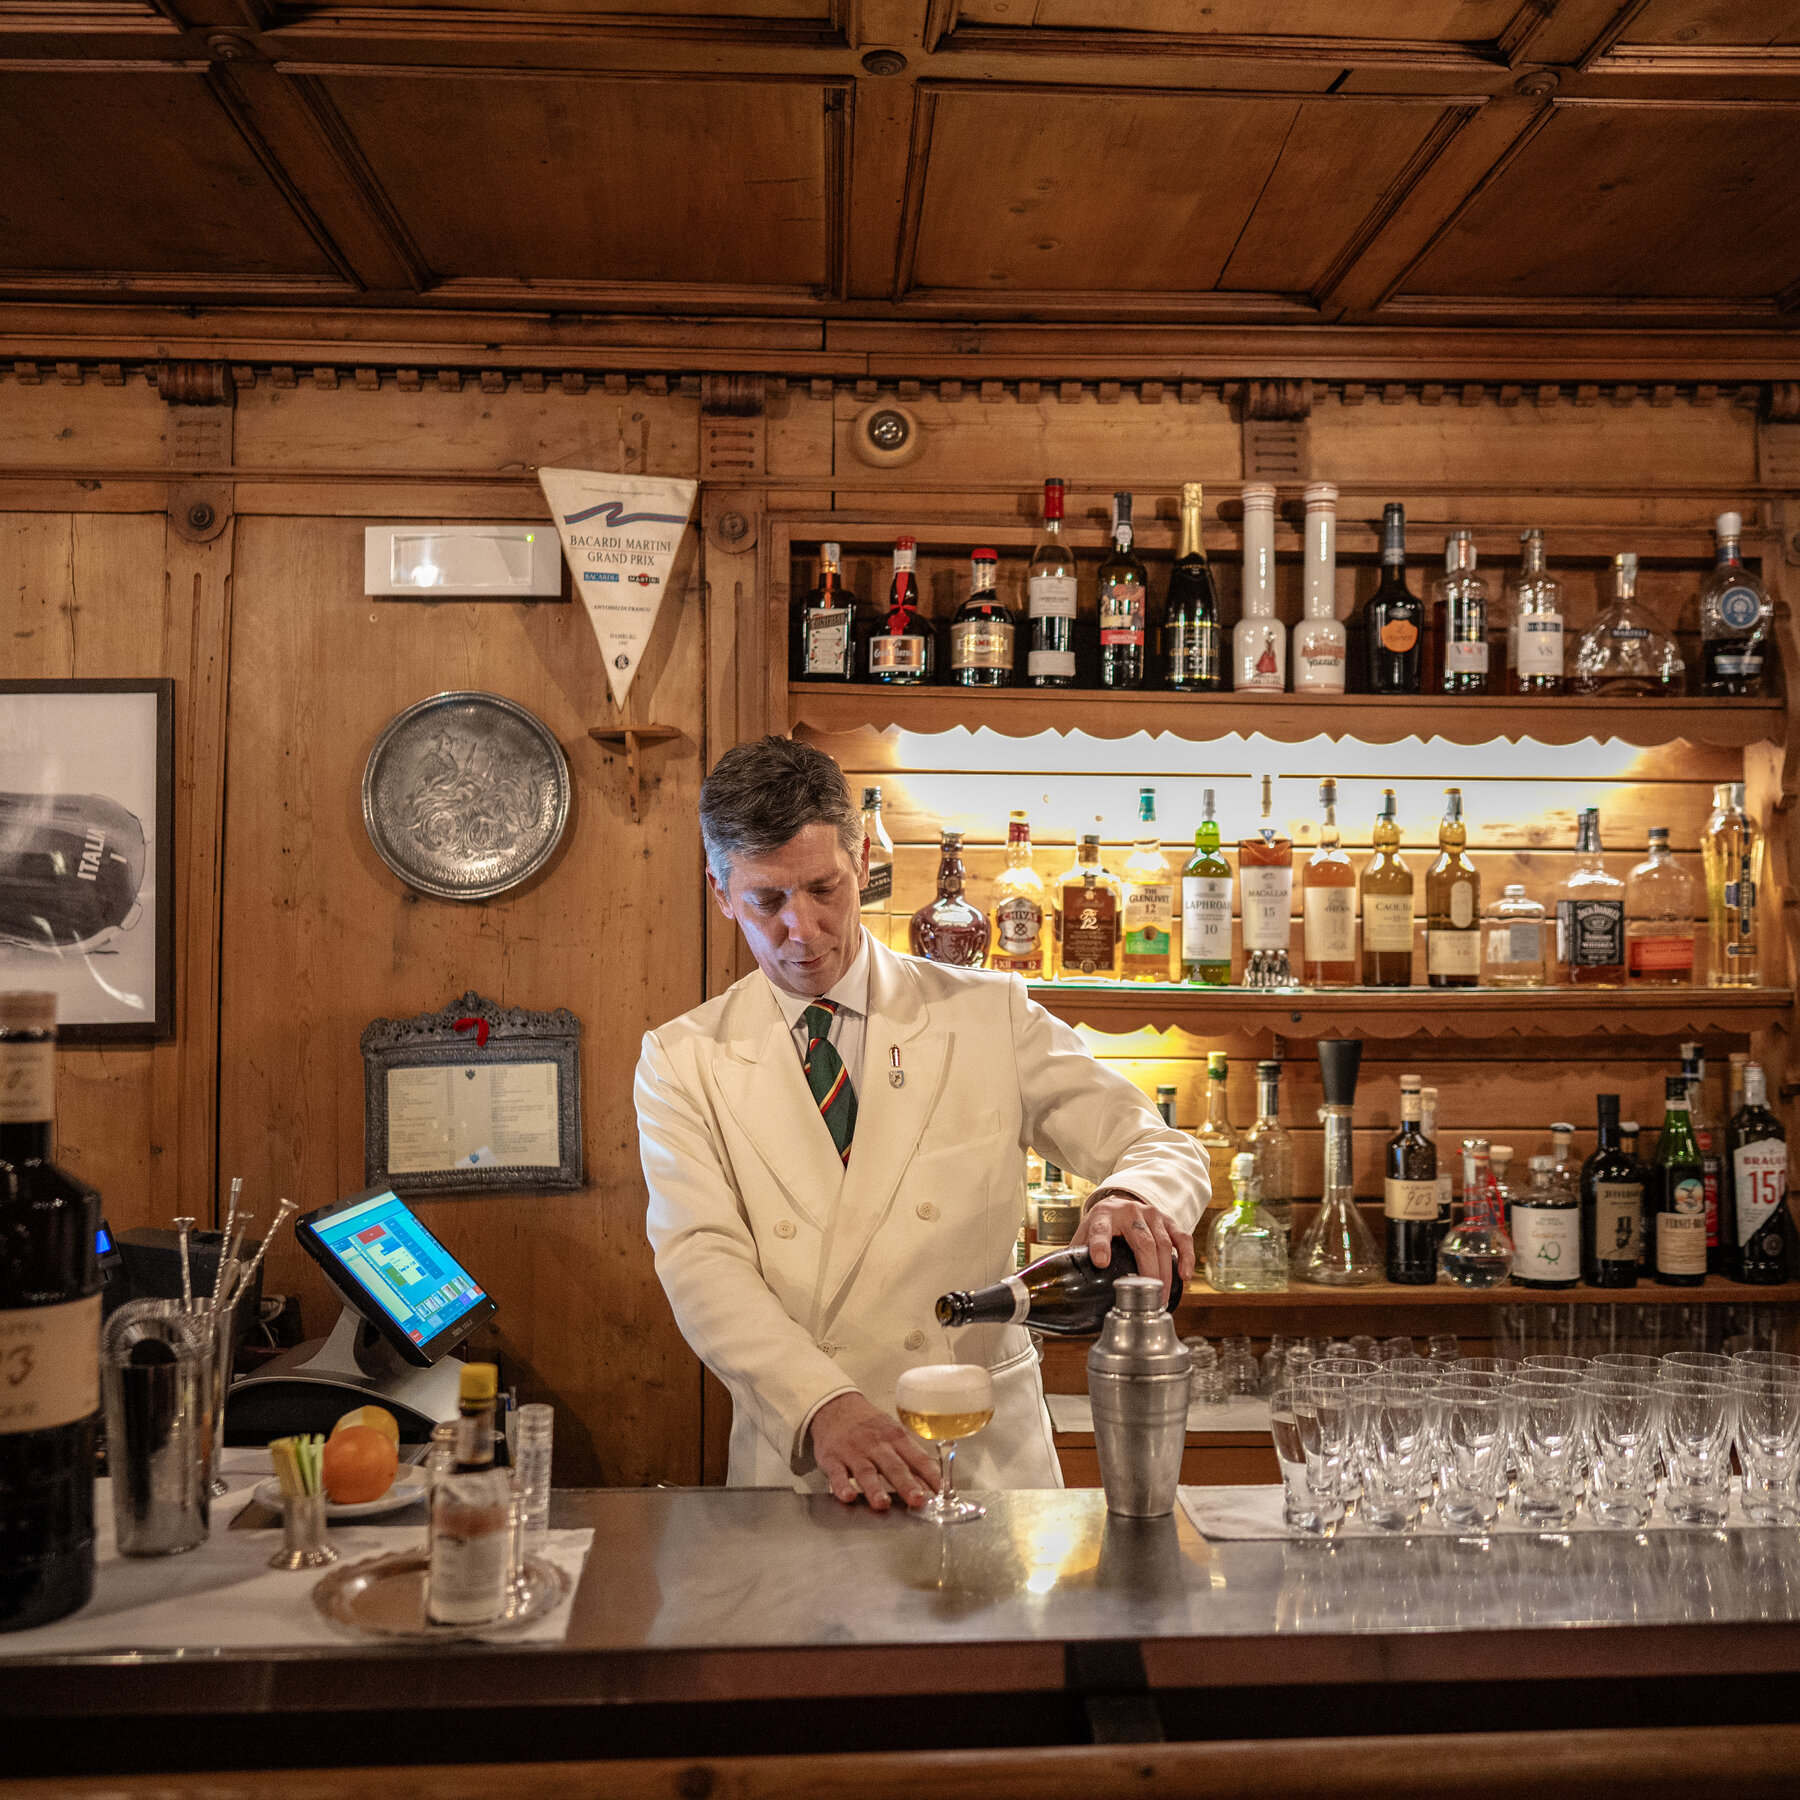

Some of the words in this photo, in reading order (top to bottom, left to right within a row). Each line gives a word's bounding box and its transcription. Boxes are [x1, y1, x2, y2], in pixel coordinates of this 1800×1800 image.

[570, 534, 621, 549] BACARDI
[626, 538, 671, 552] MARTINI
[587, 551, 628, 564] GRAND
[630, 554, 655, 566] PRIX
[77, 828, 106, 881] ITALIA
[1248, 889, 1289, 897] MACALLAN
[1129, 895, 1169, 904] GLENLIVET
[1145, 904, 1157, 913] 12
[1264, 907, 1276, 918] 15
[1375, 902, 1401, 912] CAOL
[1002, 911, 1038, 921] CHIVAS
[1577, 906, 1594, 921] JACK
[1079, 917, 1099, 930] 12
[1204, 924, 1219, 935] 10
[1405, 1190, 1433, 1212] 903
